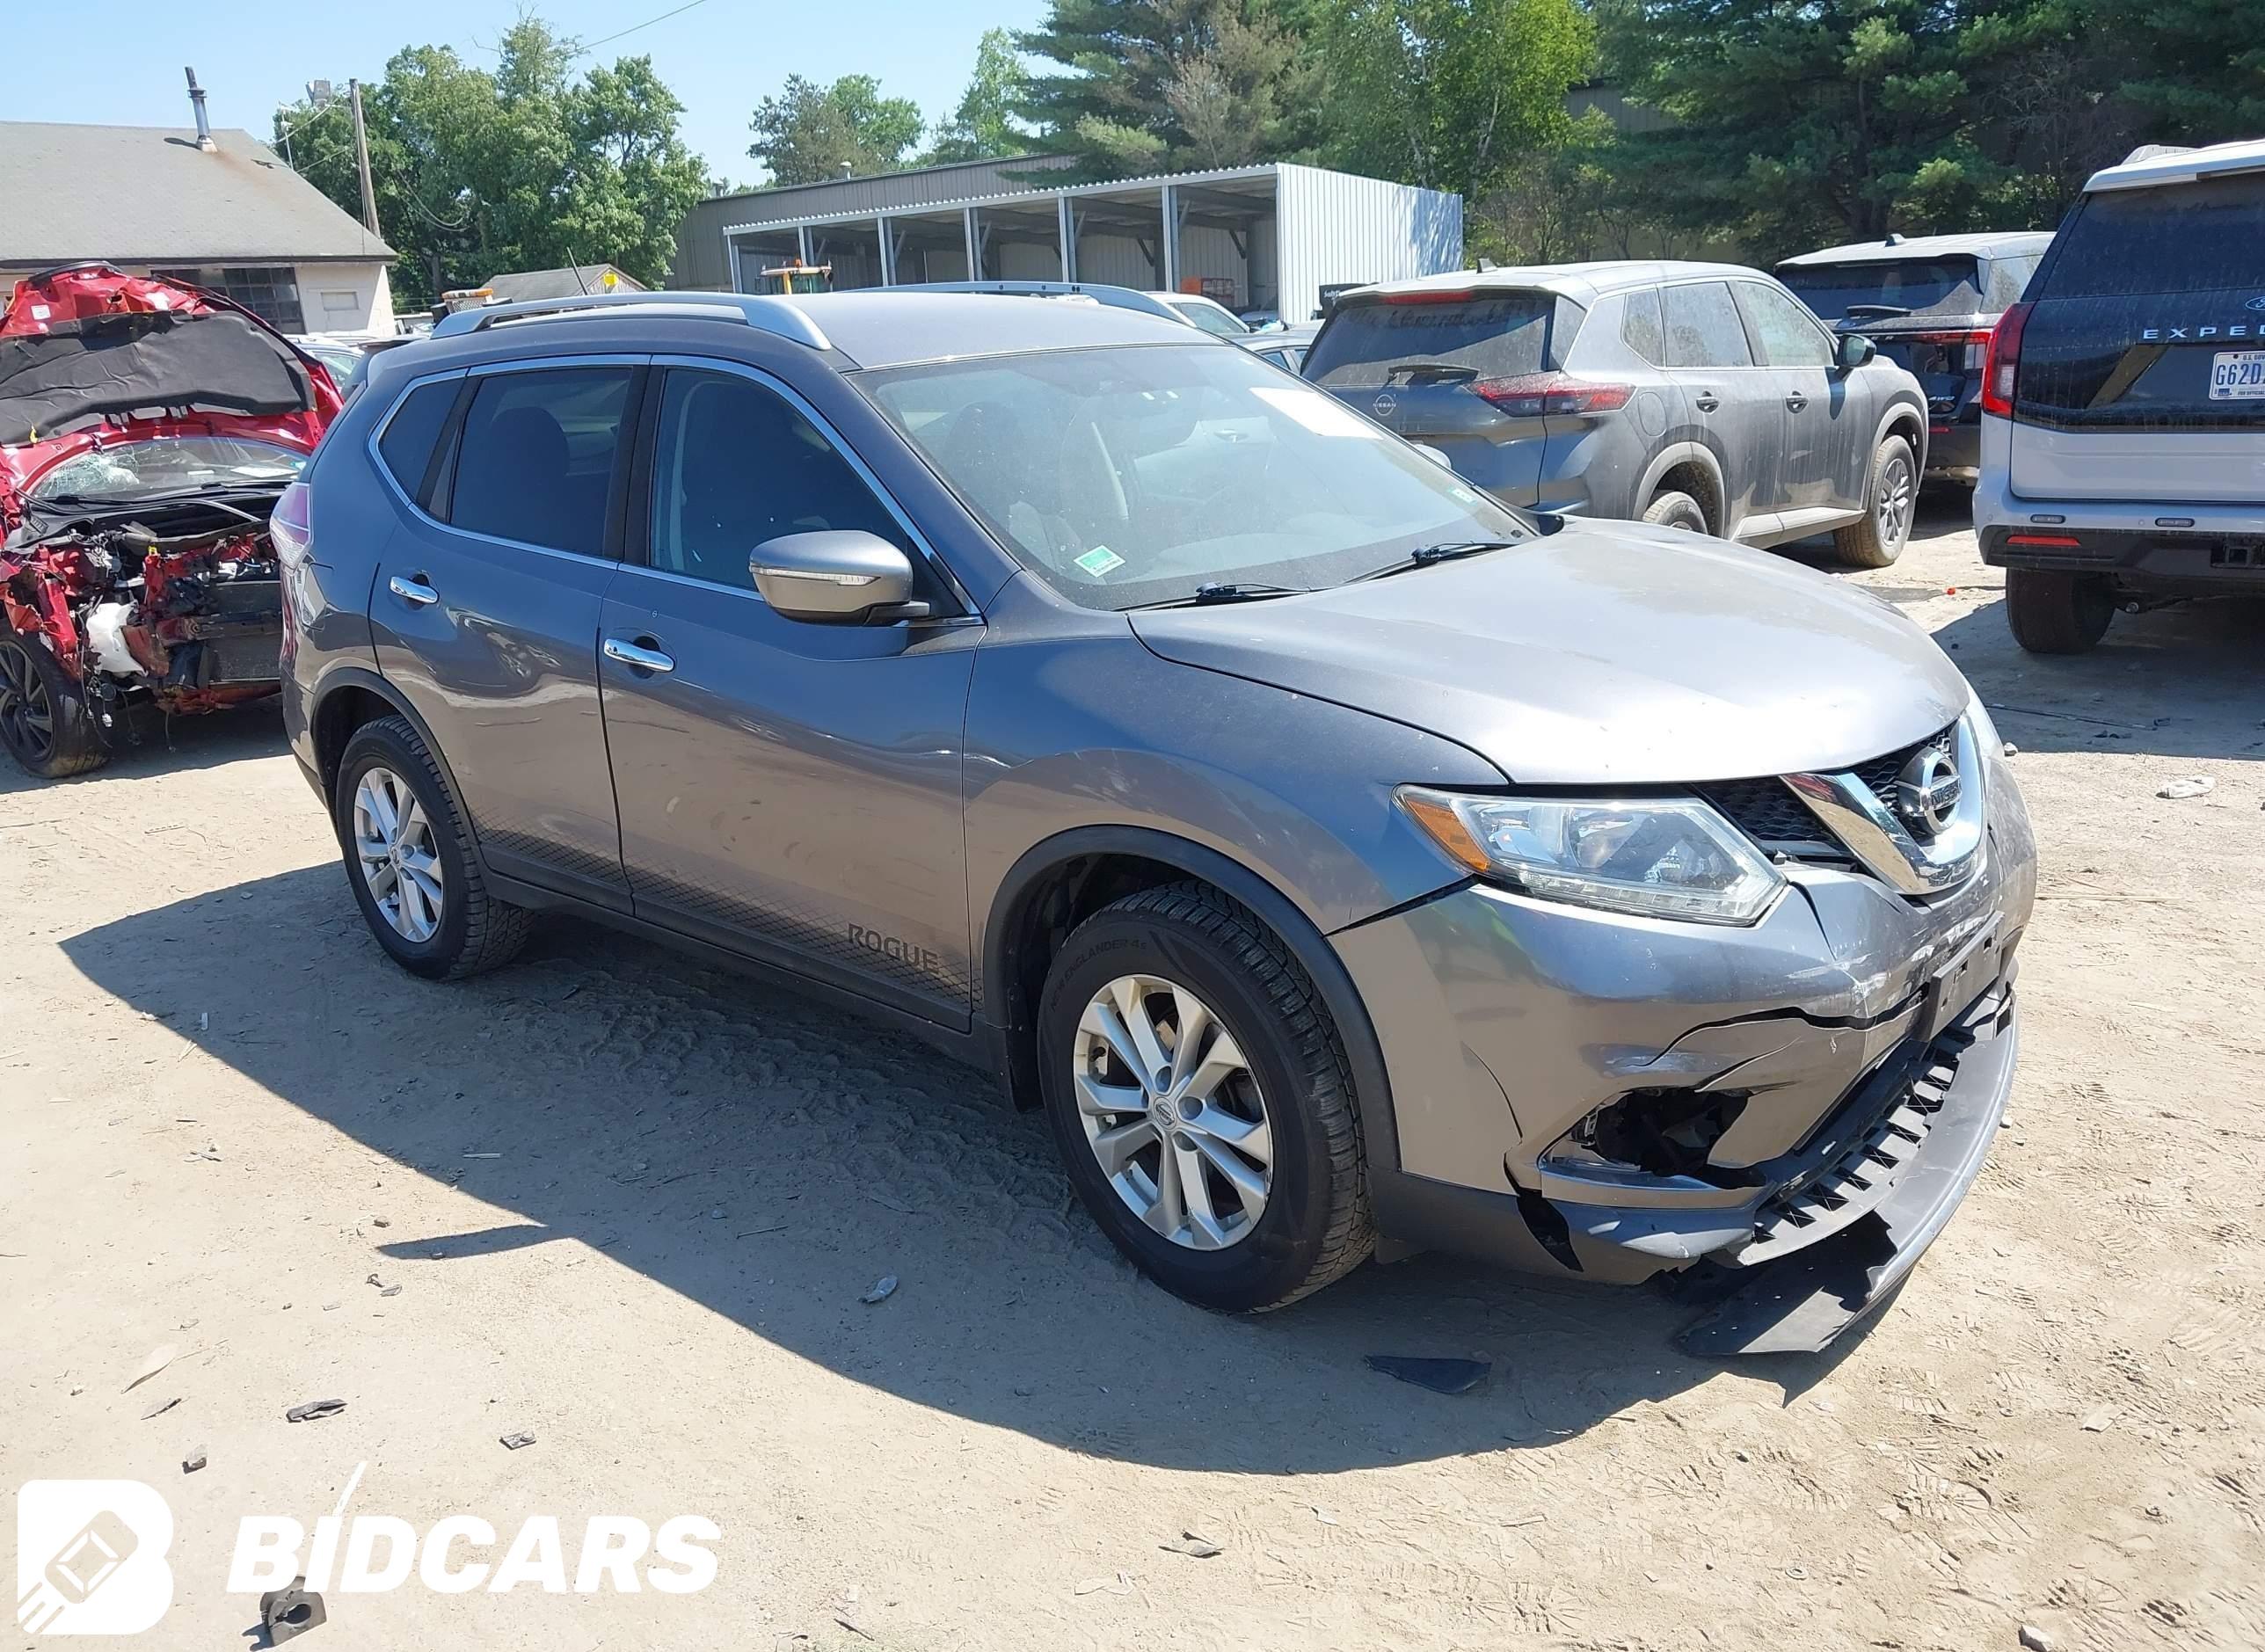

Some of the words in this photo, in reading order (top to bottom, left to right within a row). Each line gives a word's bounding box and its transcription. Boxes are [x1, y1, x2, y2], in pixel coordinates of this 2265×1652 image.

[2216, 363, 2265, 385] G62D
[848, 923, 940, 974] ROGUE
[1064, 938, 1128, 980] ENGLANDER
